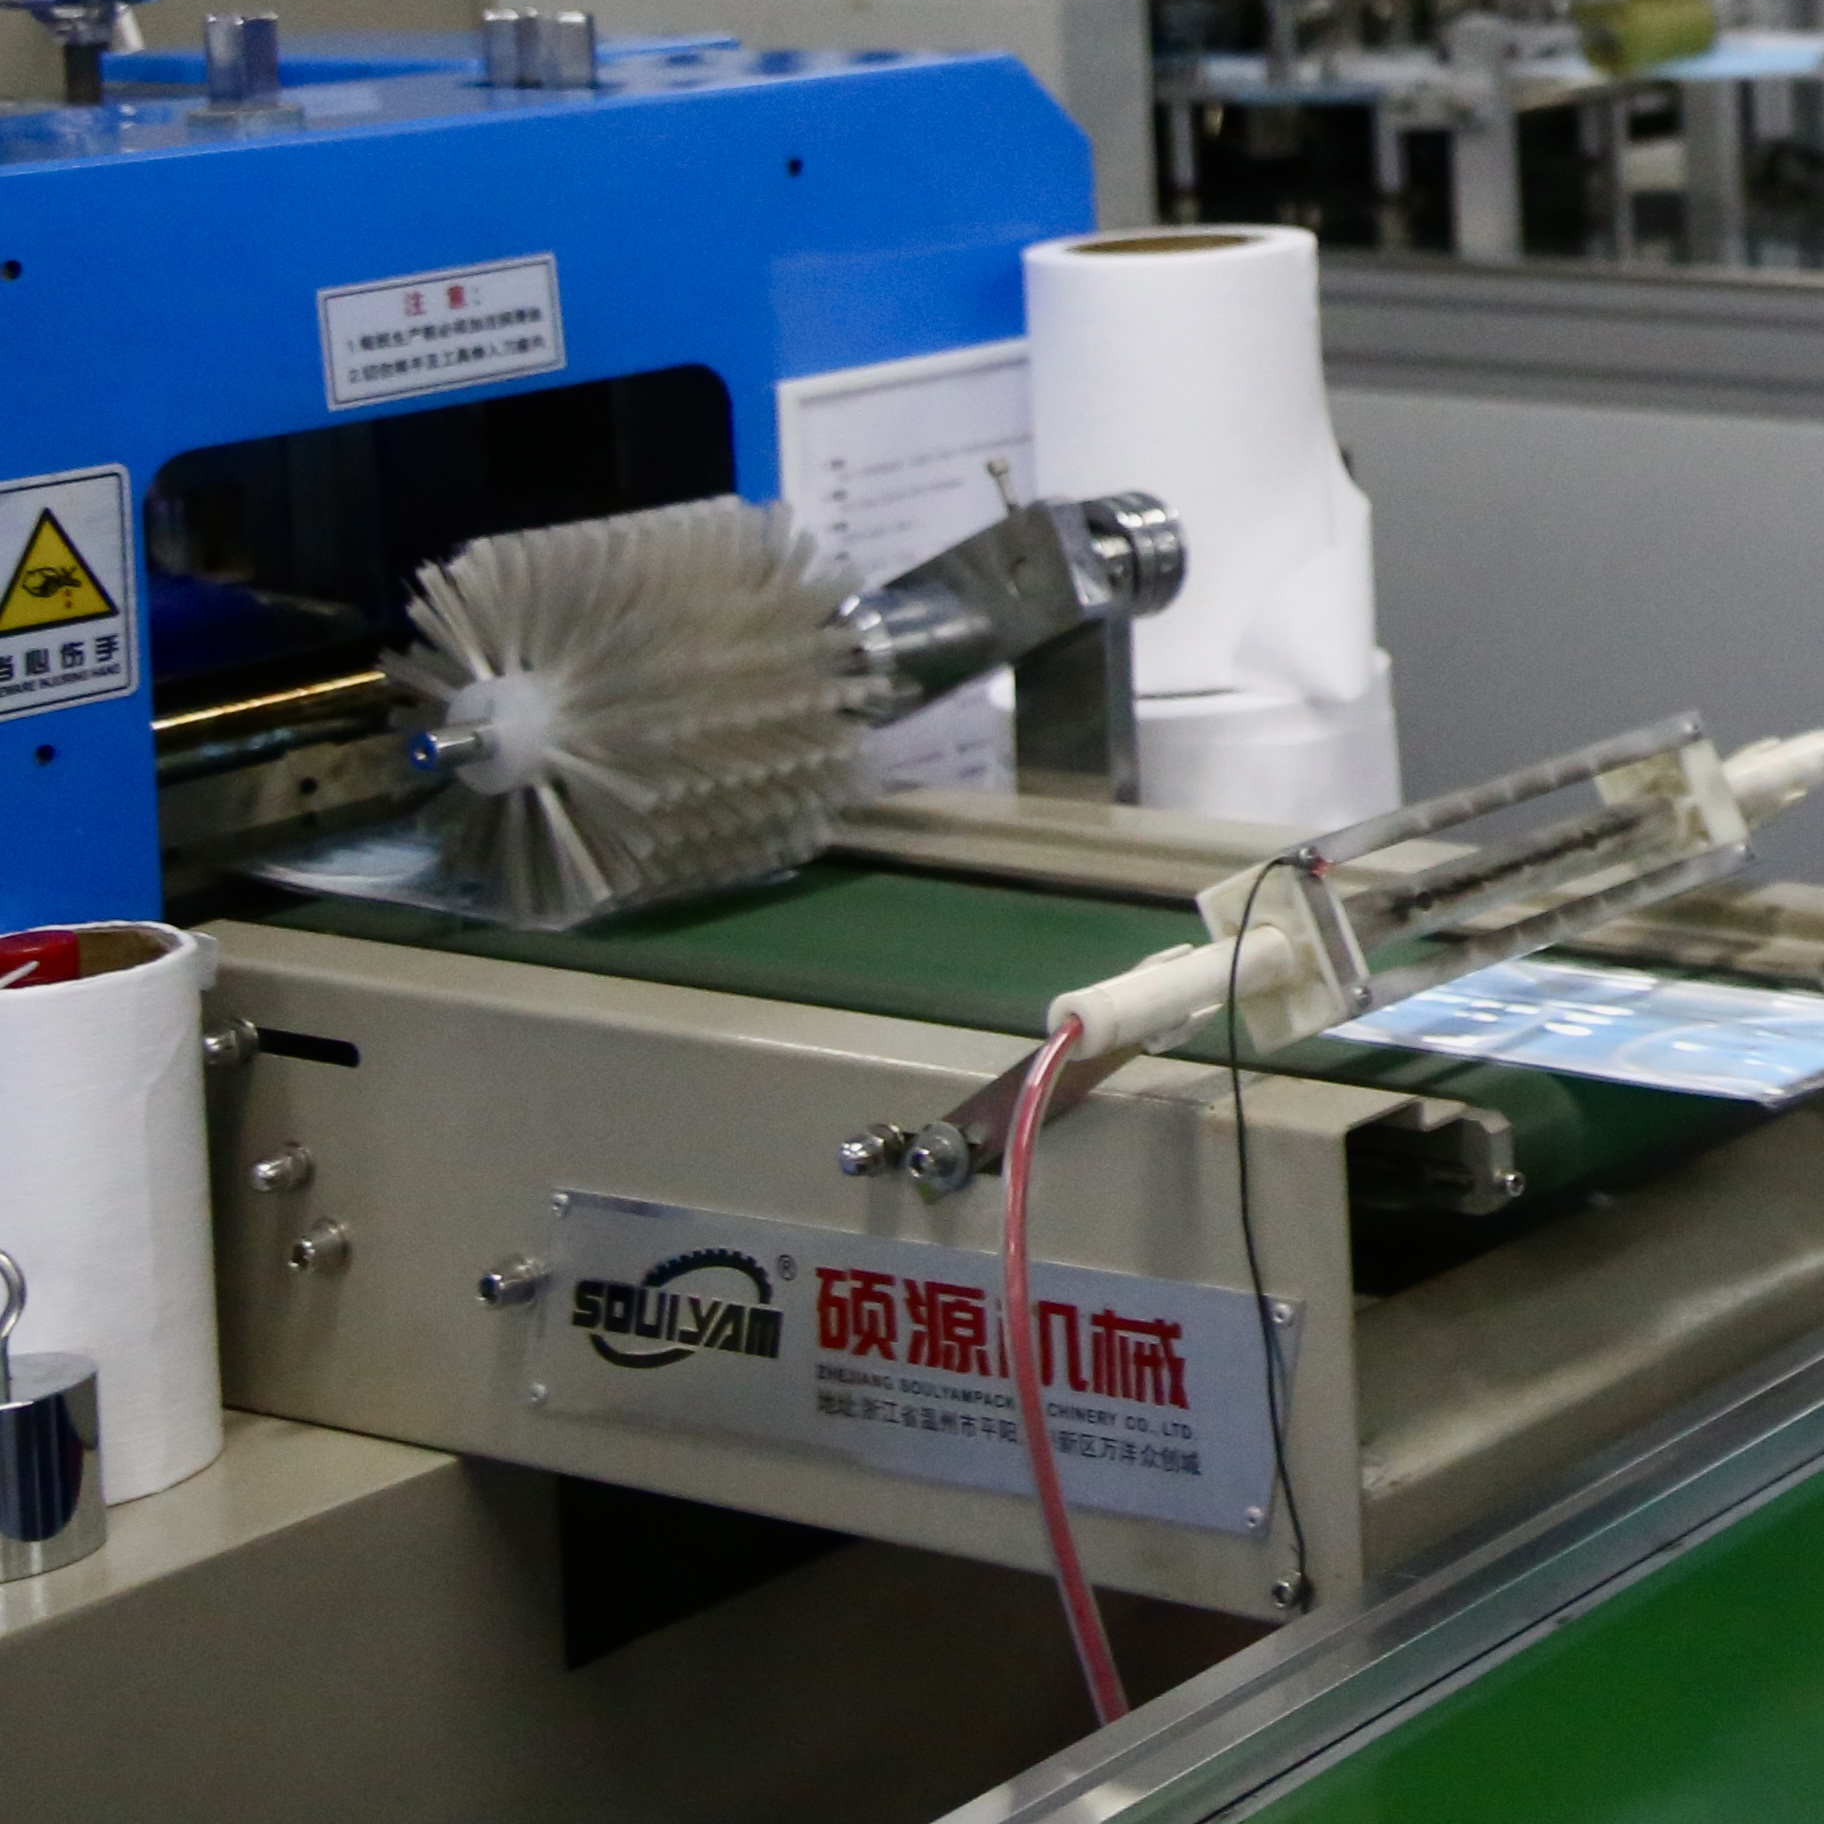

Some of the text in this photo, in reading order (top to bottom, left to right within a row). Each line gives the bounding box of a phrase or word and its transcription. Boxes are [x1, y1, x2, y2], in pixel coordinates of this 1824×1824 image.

[815, 1266, 1190, 1410] 硕源机械
[816, 1363, 894, 1391] ZHEJIANG
